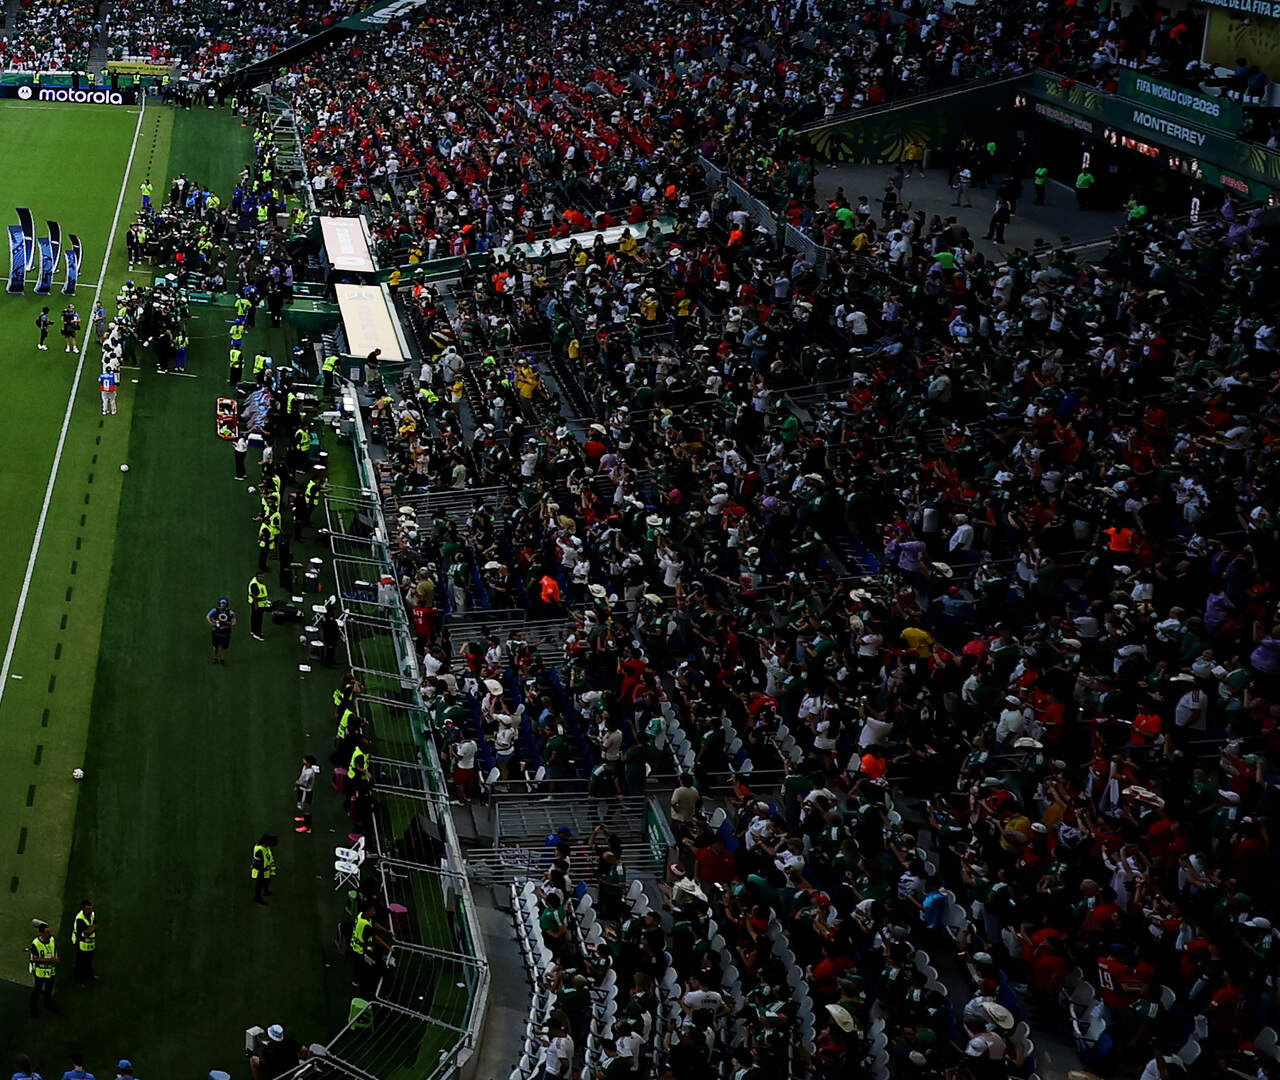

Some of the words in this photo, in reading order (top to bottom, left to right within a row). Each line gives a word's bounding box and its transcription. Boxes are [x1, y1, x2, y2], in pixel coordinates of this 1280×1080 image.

[1252, 0, 1271, 17] FIFA
[39, 86, 123, 105] motorola
[1136, 78, 1151, 93] FIFA
[1151, 82, 1177, 103] WORLD
[1177, 90, 1192, 107] CUP
[1192, 94, 1221, 117] 2026
[1133, 110, 1206, 146] MONTERREY
[1099, 968, 1114, 991] 19
